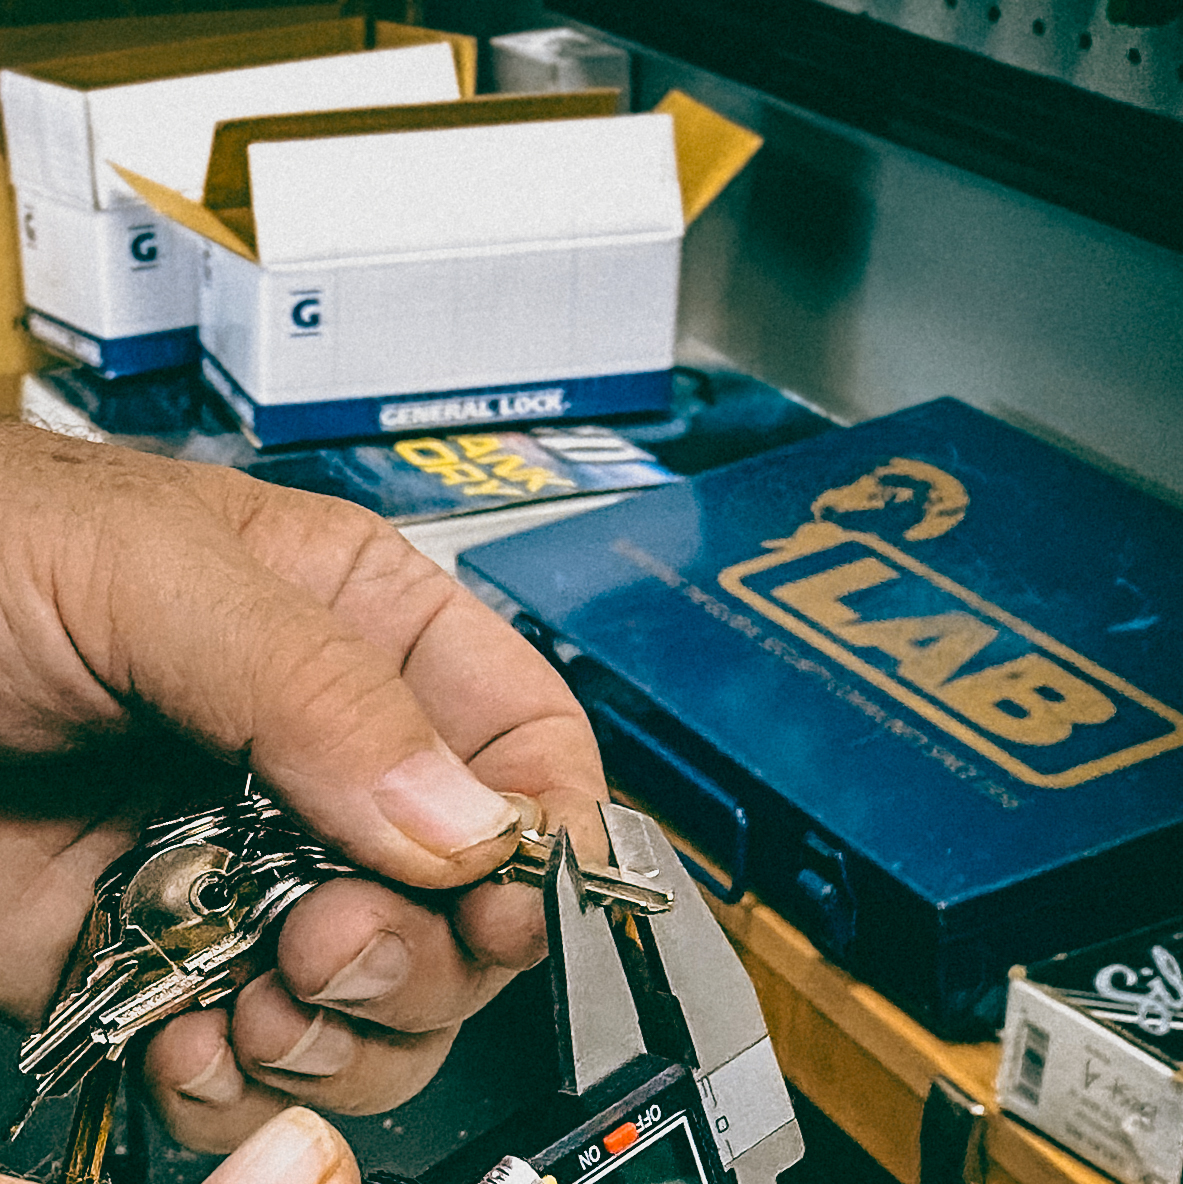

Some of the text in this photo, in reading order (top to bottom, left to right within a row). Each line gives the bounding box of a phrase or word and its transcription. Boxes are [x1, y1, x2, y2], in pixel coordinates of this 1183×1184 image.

[131, 231, 158, 263] G
[291, 298, 321, 329] G
[380, 388, 564, 431] GENERAL LOCK
[771, 556, 1117, 747] LAB
[577, 1104, 662, 1171] OFF ON
